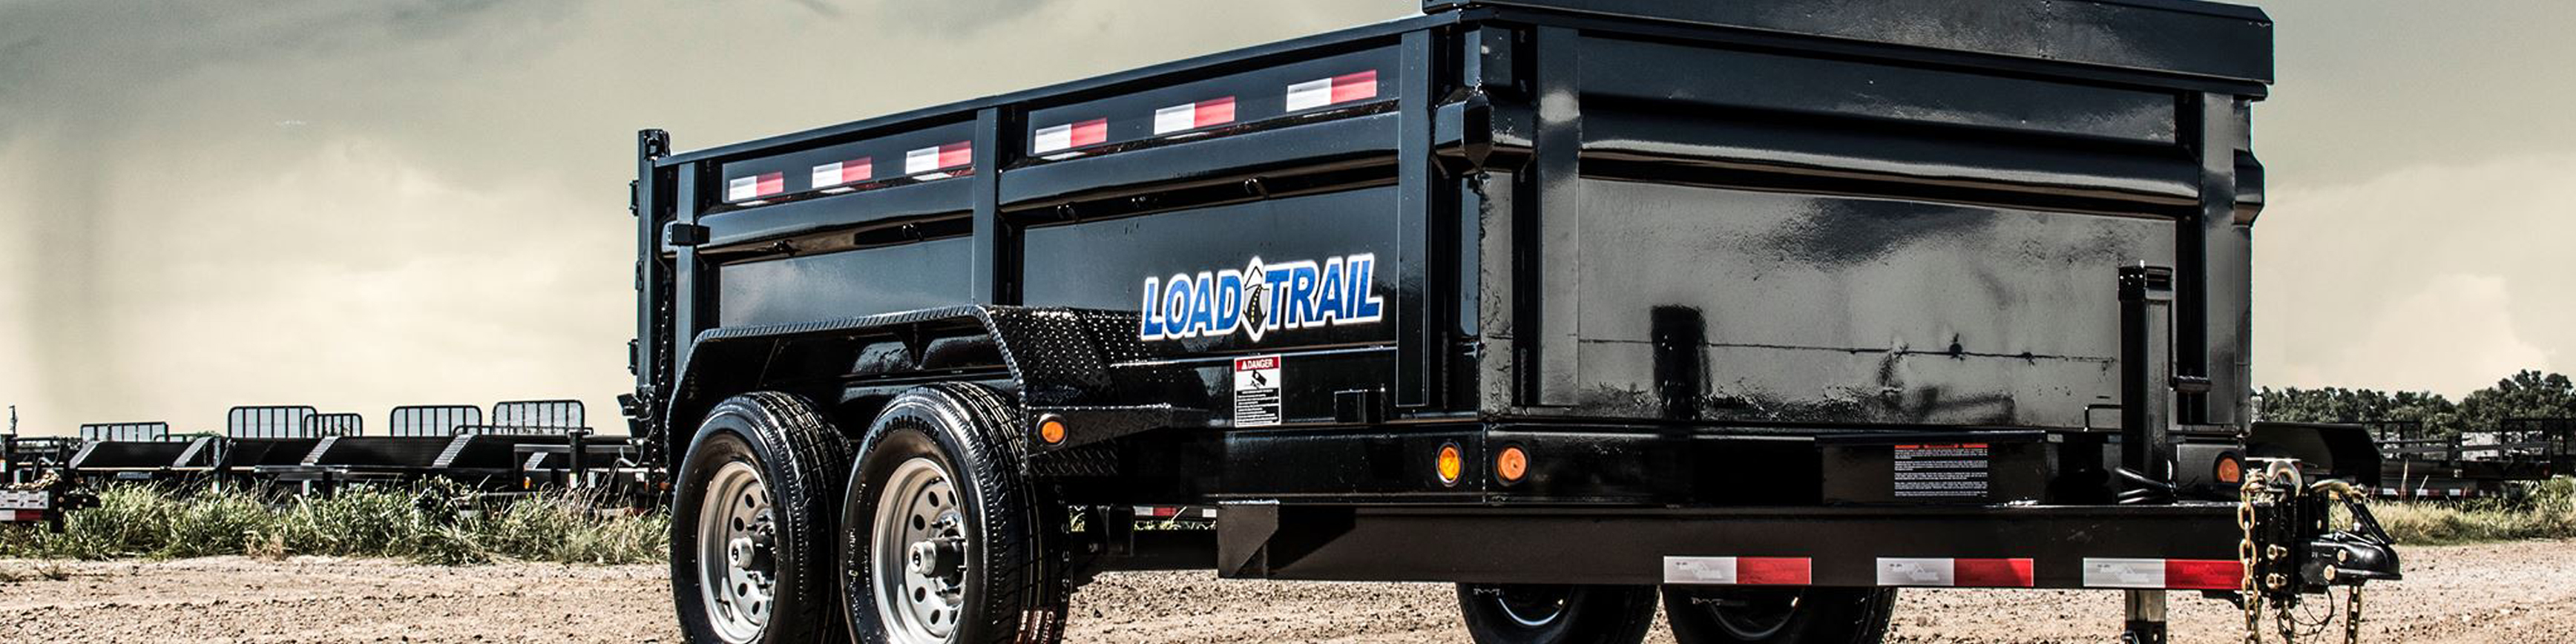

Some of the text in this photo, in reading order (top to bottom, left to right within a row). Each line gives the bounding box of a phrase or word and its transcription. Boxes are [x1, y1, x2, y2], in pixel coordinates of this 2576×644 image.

[1141, 254, 1383, 341] LOAD TRAIL
[1247, 358, 1274, 369] DANGER
